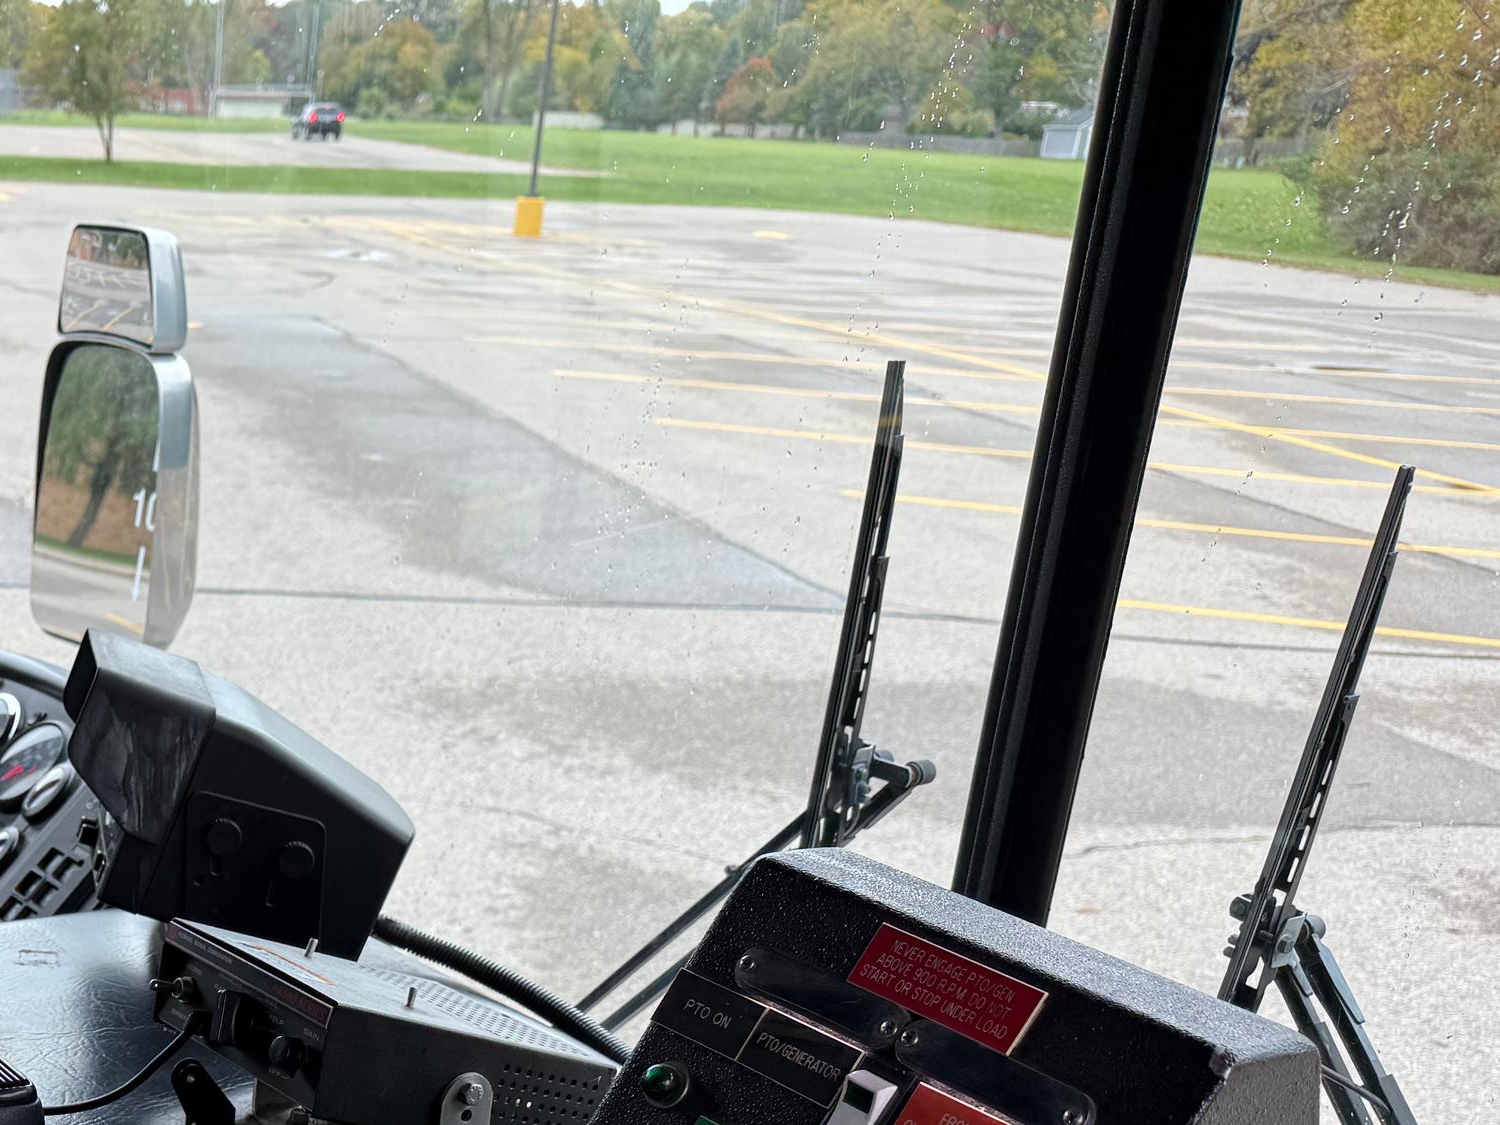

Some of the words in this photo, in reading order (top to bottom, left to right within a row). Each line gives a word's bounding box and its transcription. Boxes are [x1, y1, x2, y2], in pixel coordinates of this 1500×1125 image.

[860, 964, 897, 988] START
[895, 979, 913, 995] OR
[911, 987, 941, 1007] STOP
[940, 1000, 978, 1025] UNDER
[975, 1016, 1008, 1039] LOAD
[876, 952, 914, 977] ABOVE
[913, 968, 939, 988] 900
[967, 992, 987, 1010] DO
[985, 1000, 1012, 1020] NOT
[891, 940, 927, 962] NEVER
[925, 954, 967, 982] ENGAGE
[965, 971, 1016, 1003] PTO/GEN
[683, 999, 711, 1019] PTO
[712, 1012, 732, 1029] ON
[756, 1032, 842, 1081] PTO/GENERATOR
